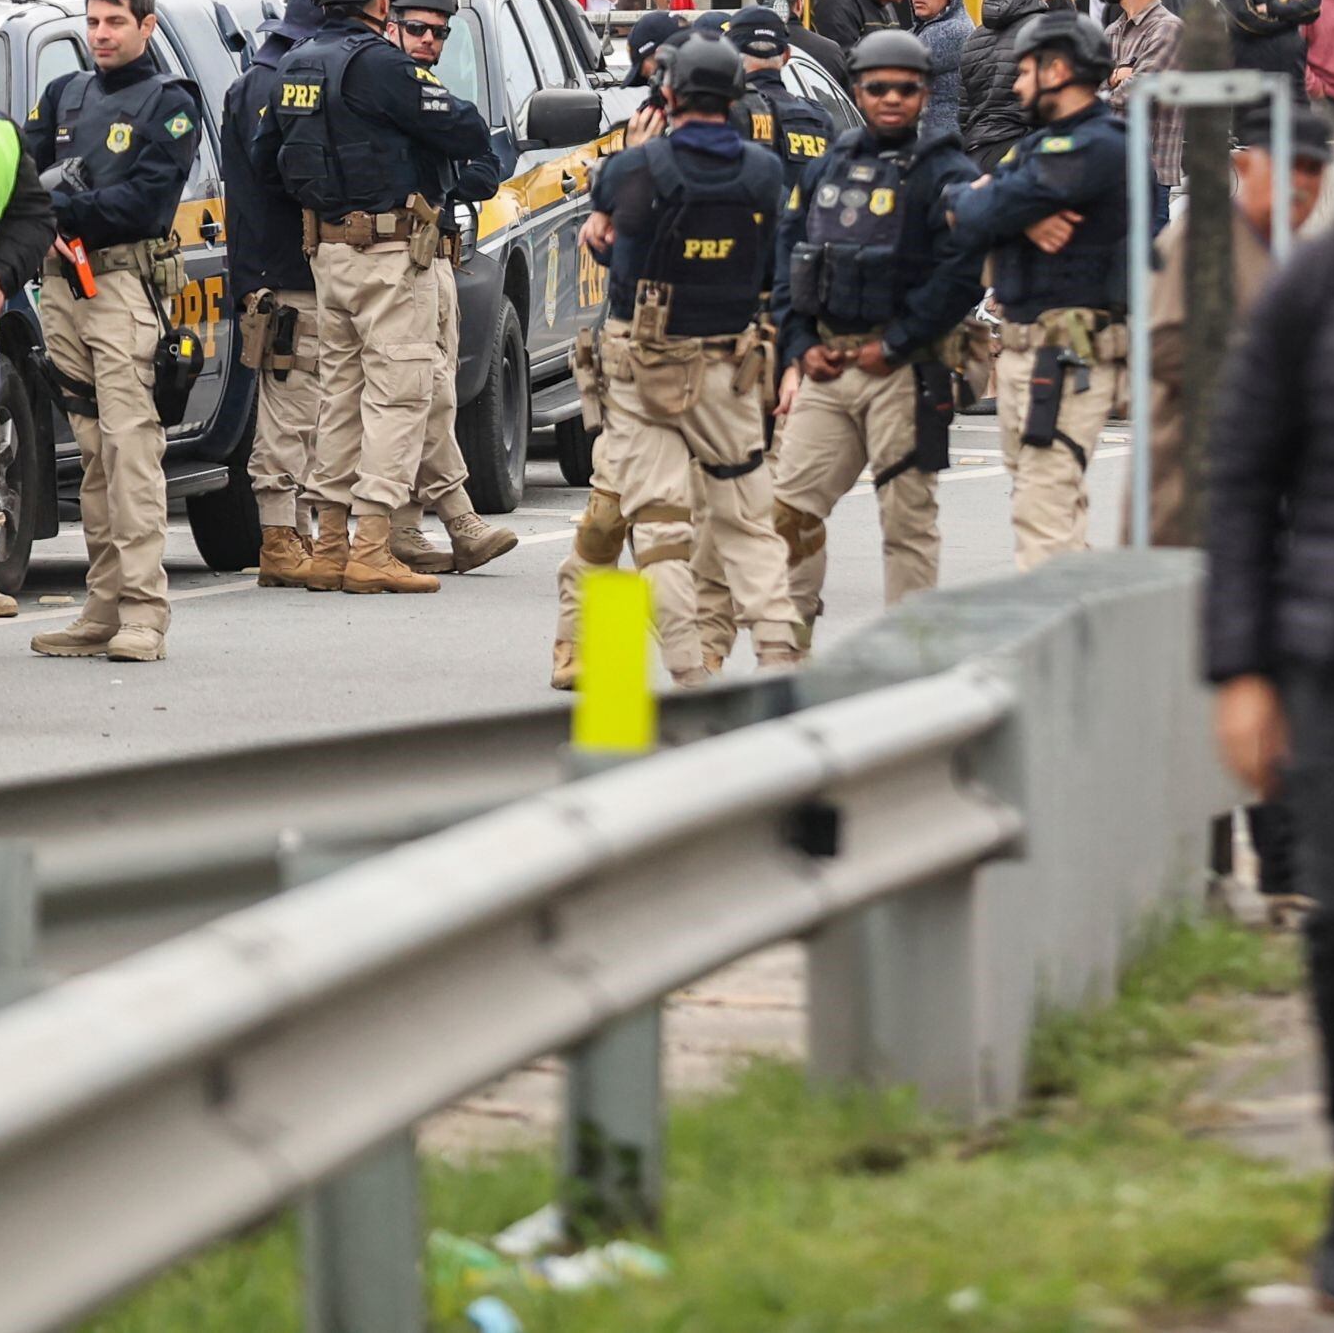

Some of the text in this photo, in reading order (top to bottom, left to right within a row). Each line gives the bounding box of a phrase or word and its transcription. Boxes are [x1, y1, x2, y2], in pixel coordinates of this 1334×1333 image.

[281, 83, 321, 109] PRF
[787, 131, 826, 158] PRF
[682, 238, 734, 259] PRF
